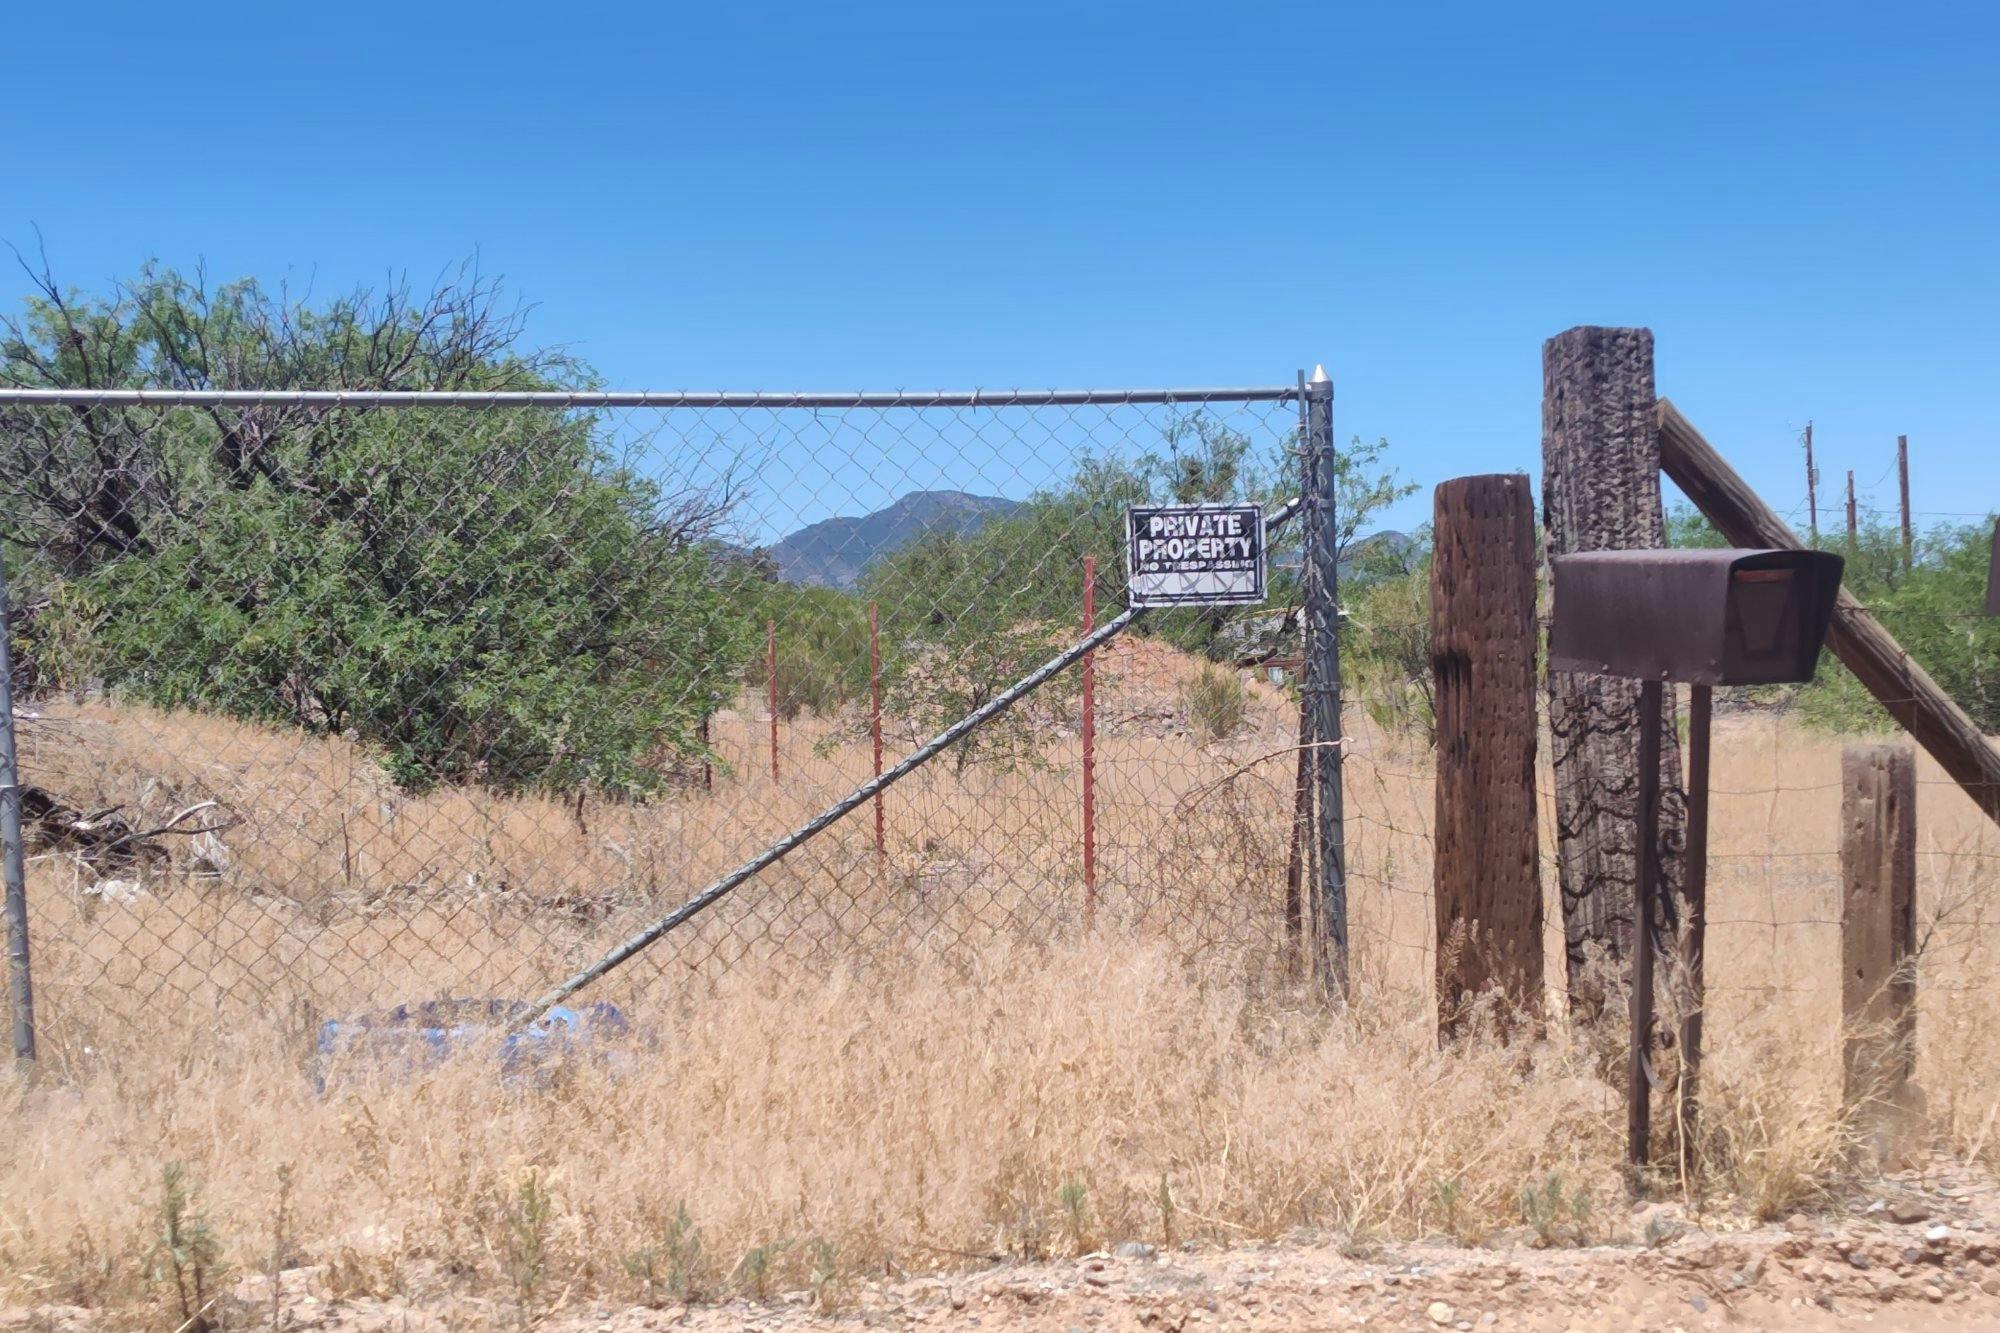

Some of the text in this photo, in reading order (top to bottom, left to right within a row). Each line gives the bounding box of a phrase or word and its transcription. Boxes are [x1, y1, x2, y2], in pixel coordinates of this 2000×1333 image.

[1150, 514, 1242, 537] PRIVATE
[1139, 537, 1252, 560] PROPERTY
[1141, 561, 1159, 571] NO
